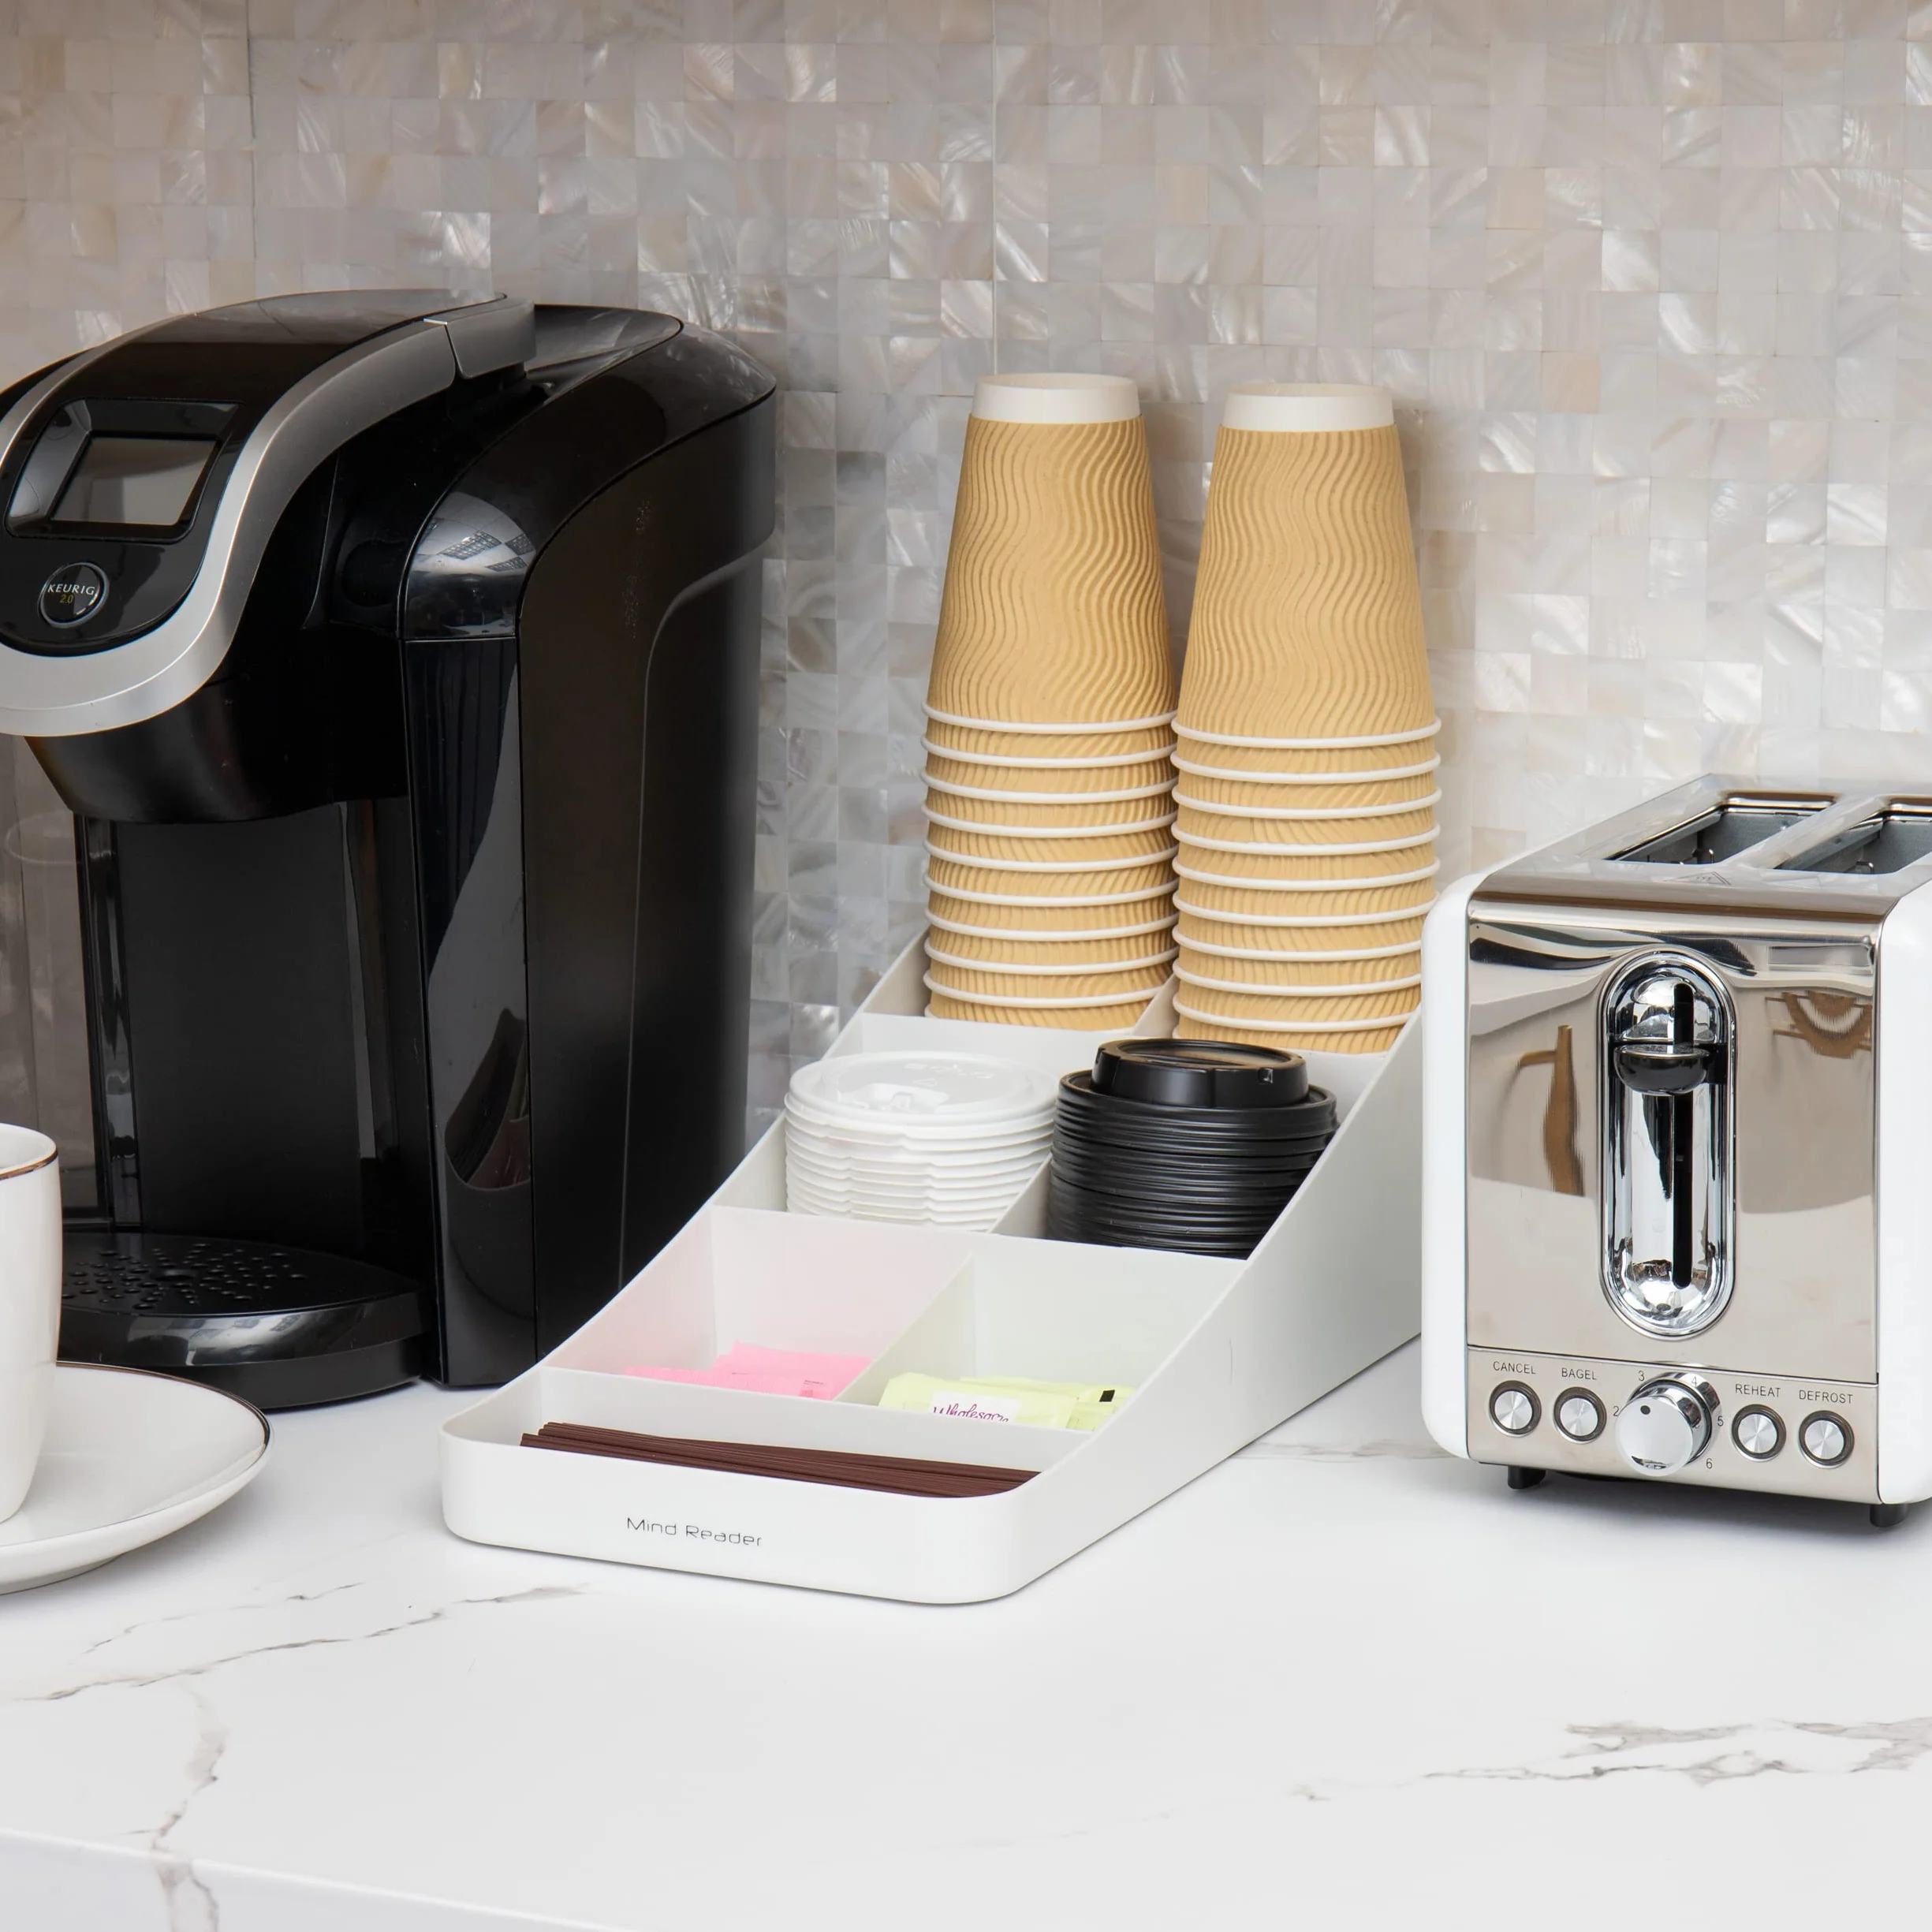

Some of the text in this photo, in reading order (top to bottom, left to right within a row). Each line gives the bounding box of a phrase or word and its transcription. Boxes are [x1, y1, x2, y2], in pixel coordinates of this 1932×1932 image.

[47, 584, 95, 595] KEURIG
[60, 594, 73, 603] 2.0
[1493, 1361, 1536, 1374] CANCEL
[1561, 1367, 1597, 1380] BAGEL
[1638, 1371, 1645, 1381] 3
[1735, 1383, 1781, 1398] REHEAT
[1799, 1389, 1853, 1404] DEFROST
[1613, 1405, 1620, 1417] 2
[1717, 1415, 1724, 1427] 5
[1706, 1458, 1713, 1469] 6
[627, 1517, 762, 1546] Mind Reader
